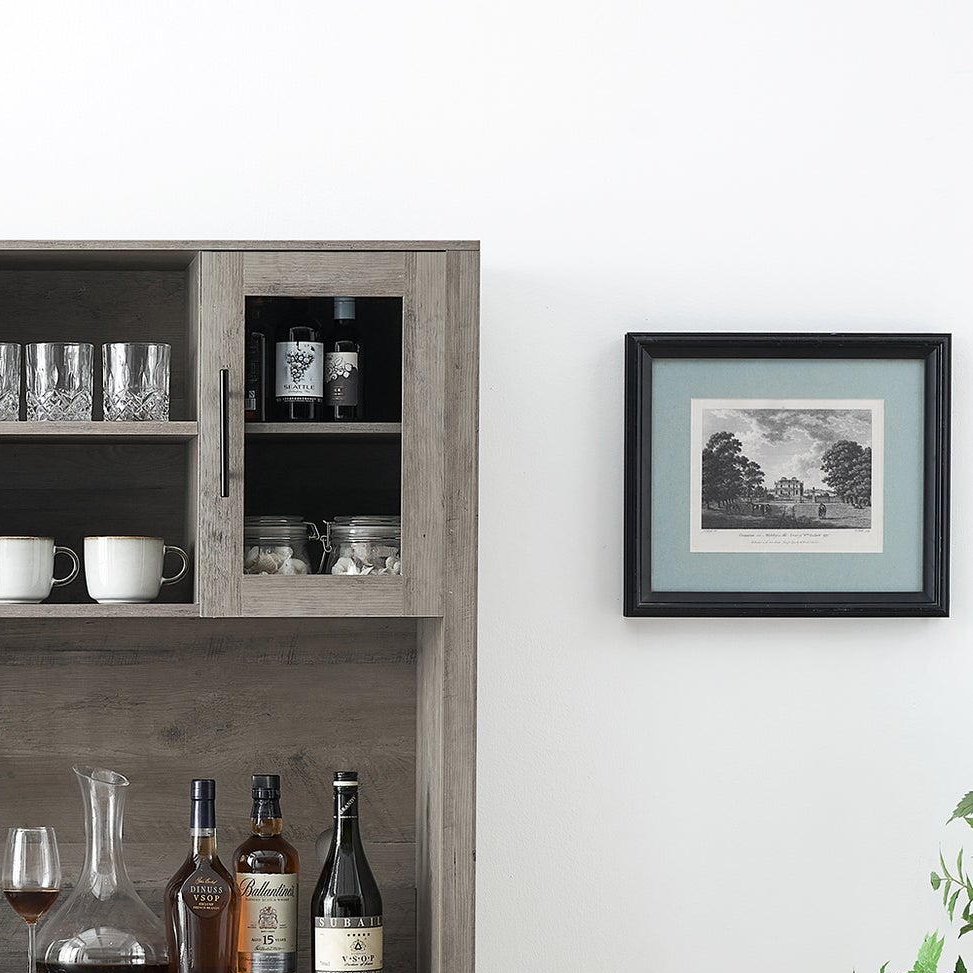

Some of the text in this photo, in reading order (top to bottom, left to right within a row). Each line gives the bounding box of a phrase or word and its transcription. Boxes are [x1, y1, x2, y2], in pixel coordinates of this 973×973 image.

[190, 885, 223, 894] DINUSS
[193, 894, 220, 902] VSOP
[263, 935, 275, 945] 15
